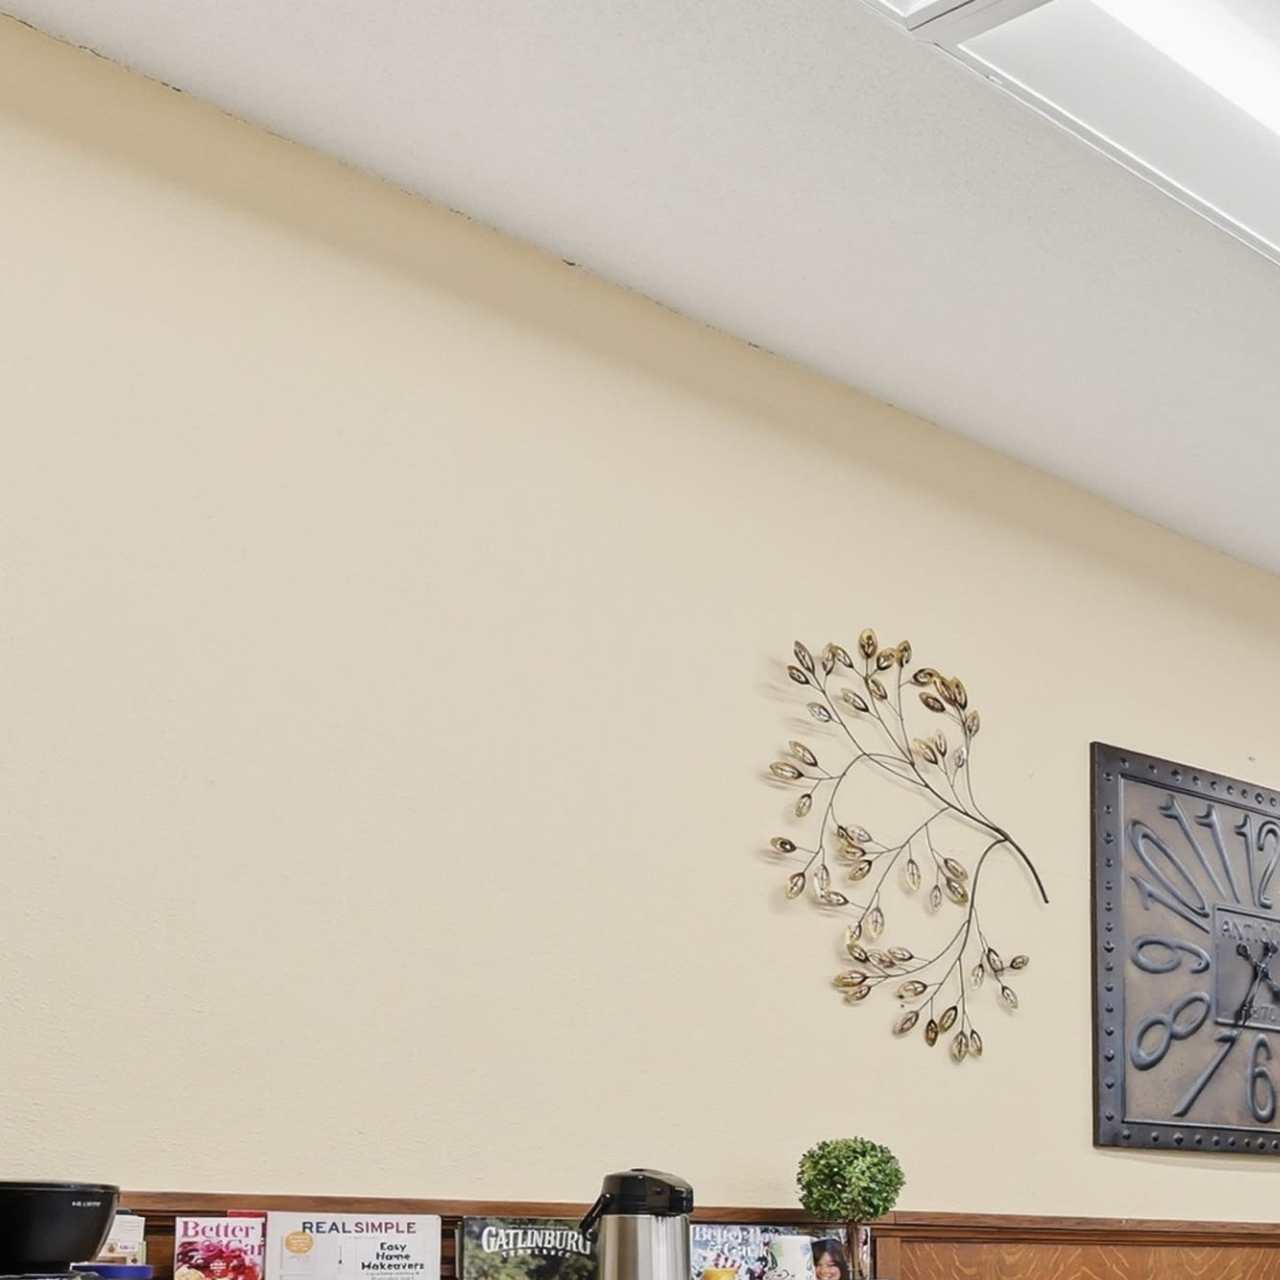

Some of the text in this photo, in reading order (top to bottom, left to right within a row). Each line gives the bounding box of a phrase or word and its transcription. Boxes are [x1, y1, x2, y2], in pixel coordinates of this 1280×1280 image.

[1132, 934, 1211, 974] 9
[1130, 991, 1211, 1071] 8
[1173, 1029, 1239, 1117] 7
[1247, 1033, 1277, 1124] 6
[182, 1221, 254, 1239] Better
[354, 1221, 417, 1235] SIMPLE
[380, 1242, 407, 1252] Easy
[481, 1226, 592, 1255] GATLINBURG
[361, 1261, 425, 1270] Makeovers
[376, 1252, 411, 1261] Home
